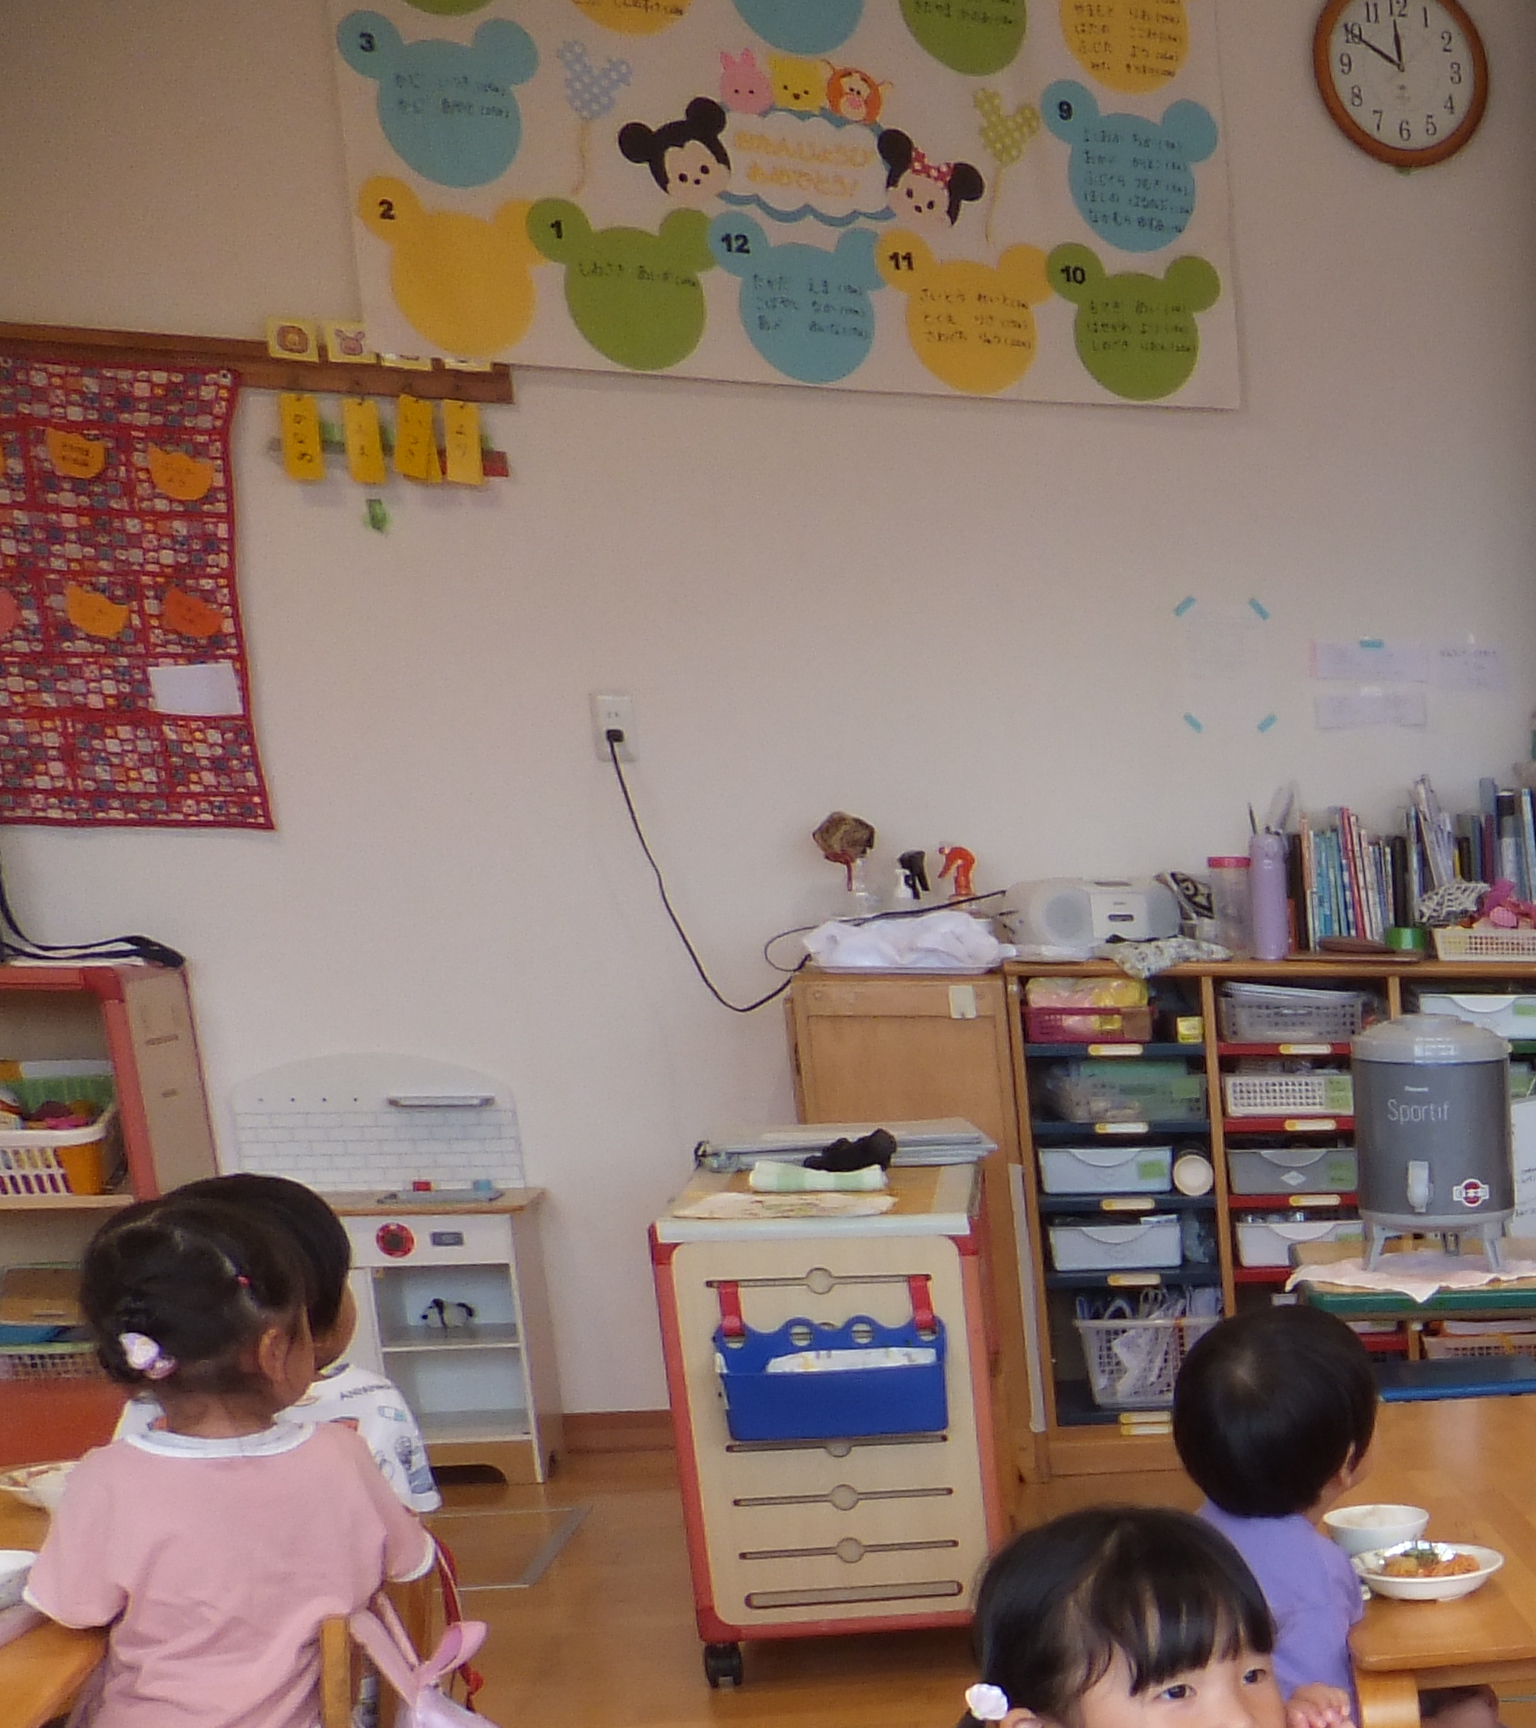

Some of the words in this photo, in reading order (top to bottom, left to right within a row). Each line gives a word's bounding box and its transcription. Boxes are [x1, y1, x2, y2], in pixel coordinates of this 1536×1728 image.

[1365, 2, 1380, 24] 11
[1389, 0, 1408, 18] 12
[1422, 7, 1429, 28] 1
[358, 32, 377, 53] 3
[1440, 31, 1453, 53] 2
[1339, 53, 1352, 75] 9
[1449, 62, 1462, 85] 3
[1351, 84, 1363, 107] 8
[1443, 94, 1455, 115] 4
[1058, 100, 1073, 121] 9
[1372, 109, 1384, 132] 7
[1399, 120, 1412, 142] 6
[1425, 114, 1437, 136] 5
[378, 200, 395, 221] 2
[550, 219, 563, 239] 1
[721, 233, 752, 254] 12
[888, 251, 915, 271] 11
[1060, 266, 1087, 285] 10
[1387, 1098, 1450, 1125] Sportif
